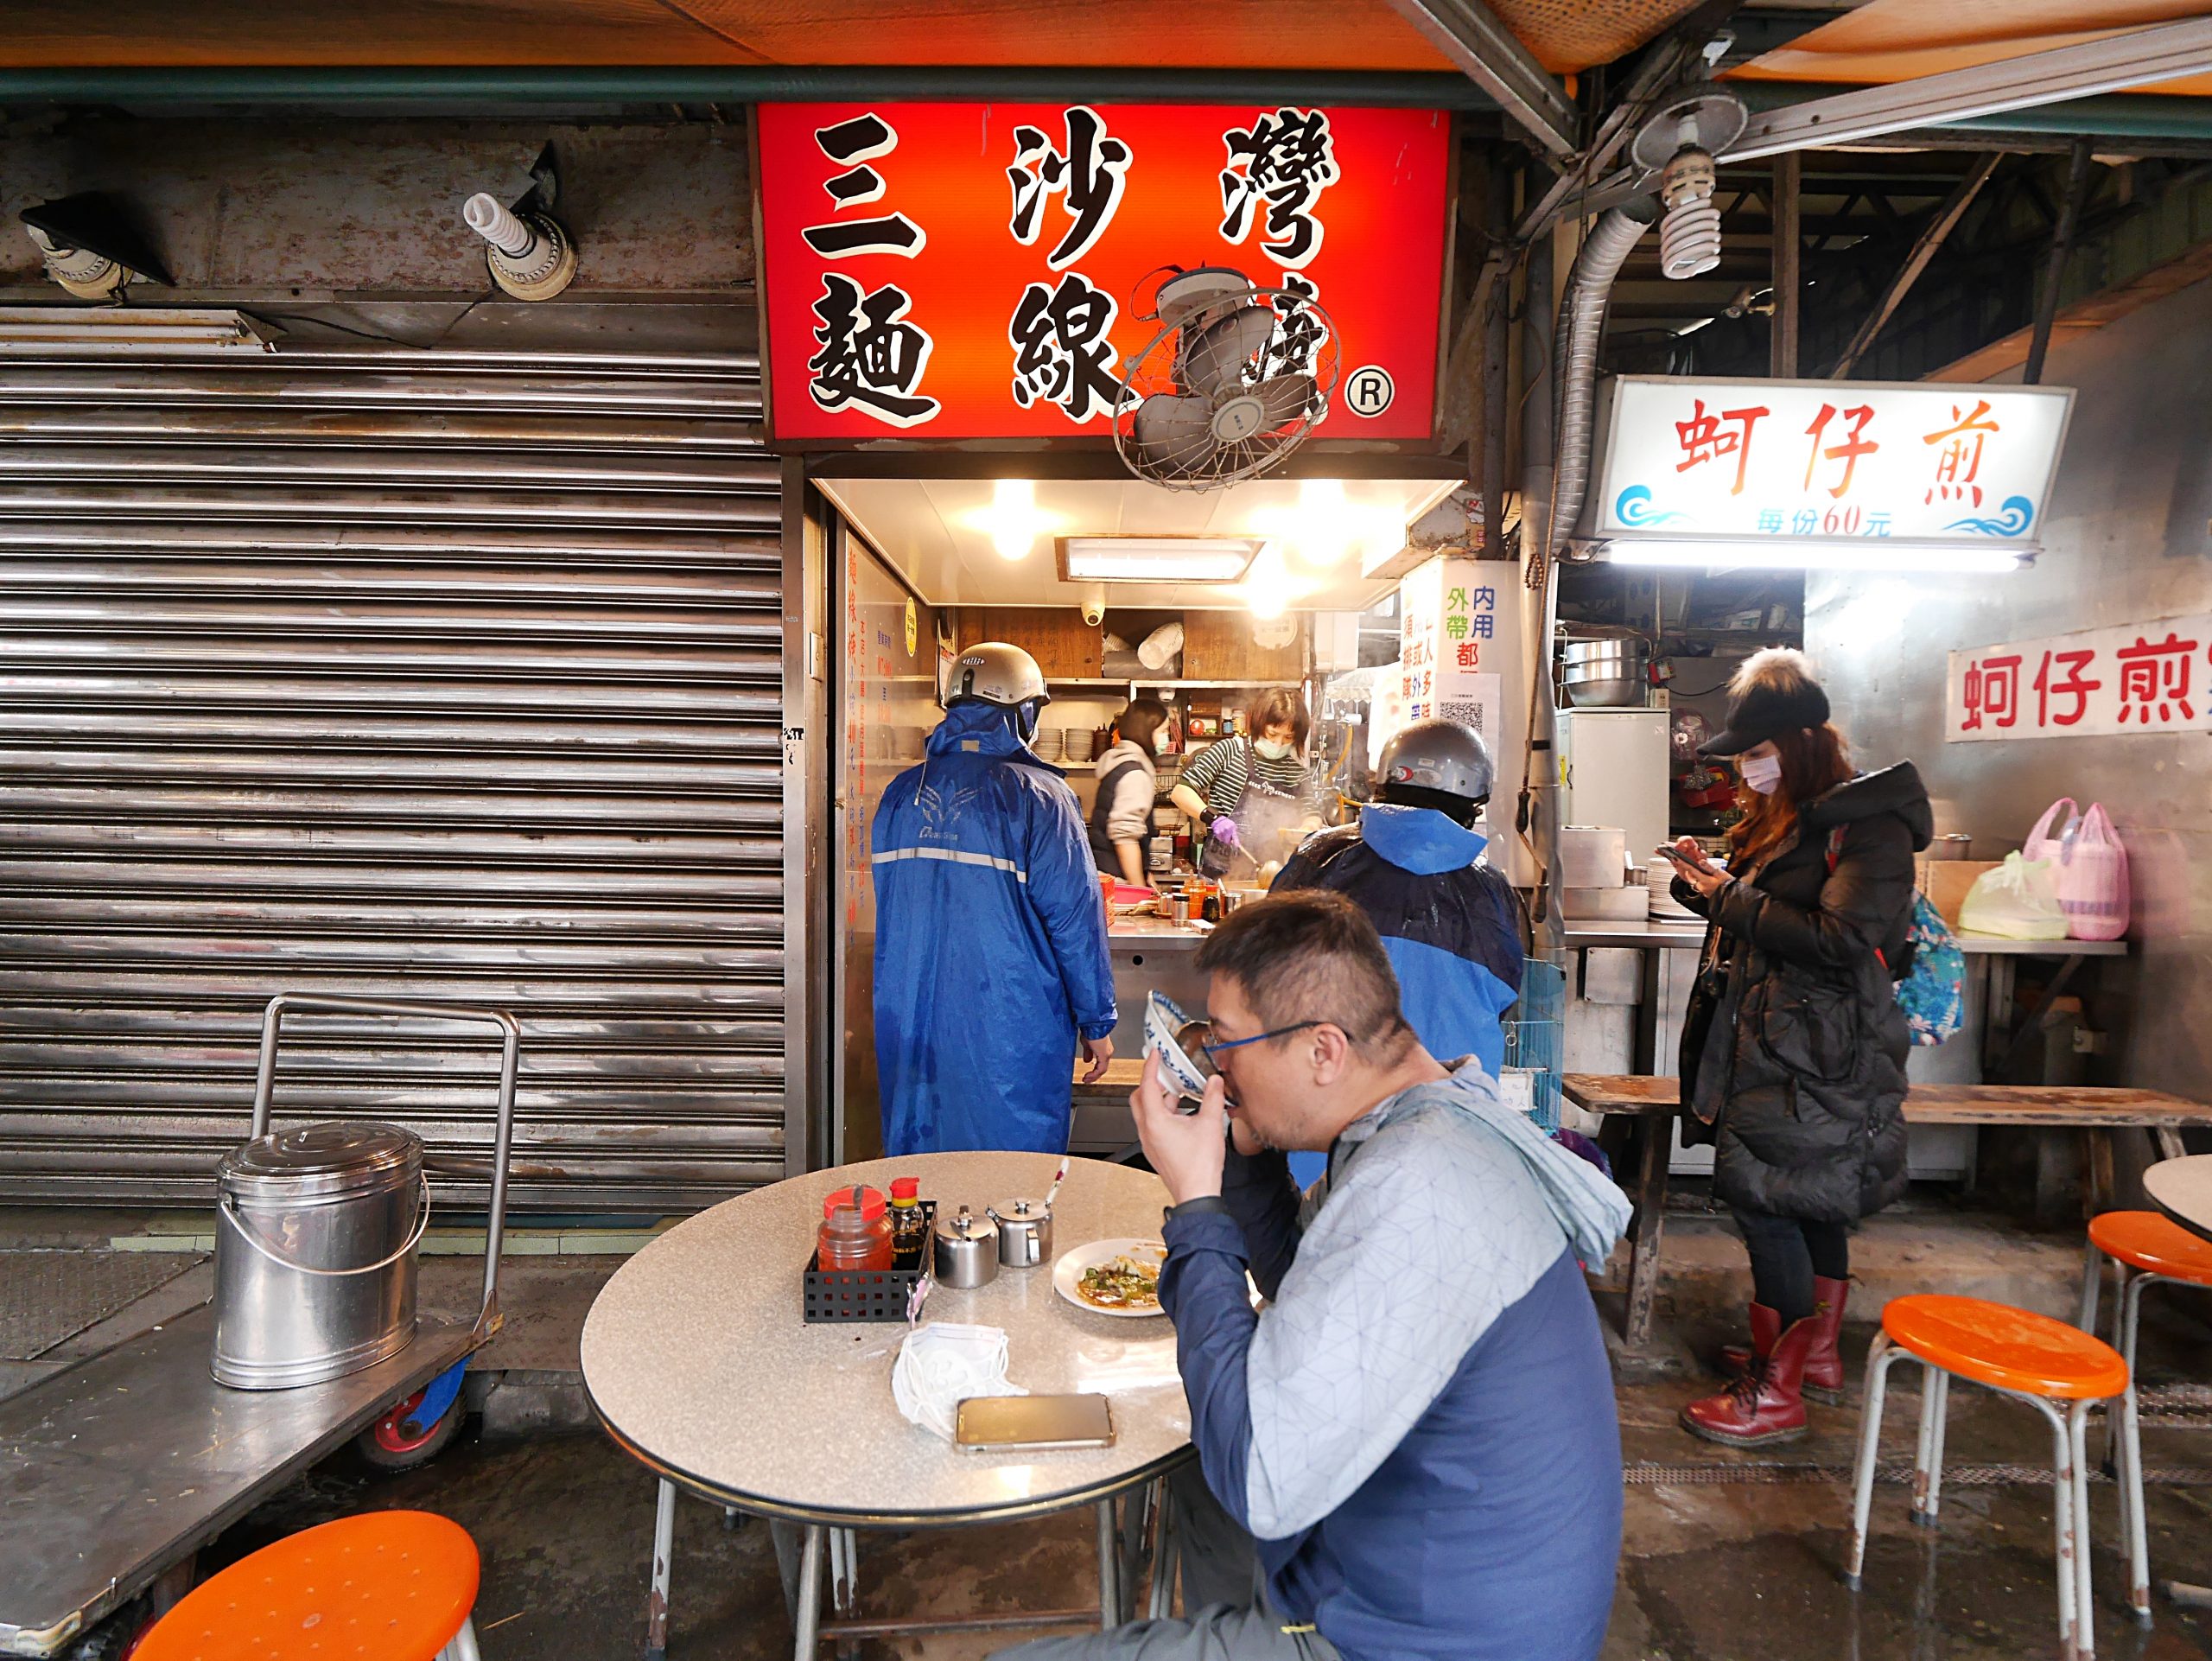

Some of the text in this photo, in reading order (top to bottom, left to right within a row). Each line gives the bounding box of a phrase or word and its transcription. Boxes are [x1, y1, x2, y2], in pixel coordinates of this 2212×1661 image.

[801, 106, 1340, 272] 三沙灣
[1675, 398, 2000, 509] 蚵仔煎
[1758, 505, 1892, 538] 每份60元
[1446, 587, 1469, 640] 外帶
[1457, 642, 1478, 673] 都
[1961, 632, 2212, 732] 蚵仔煎
